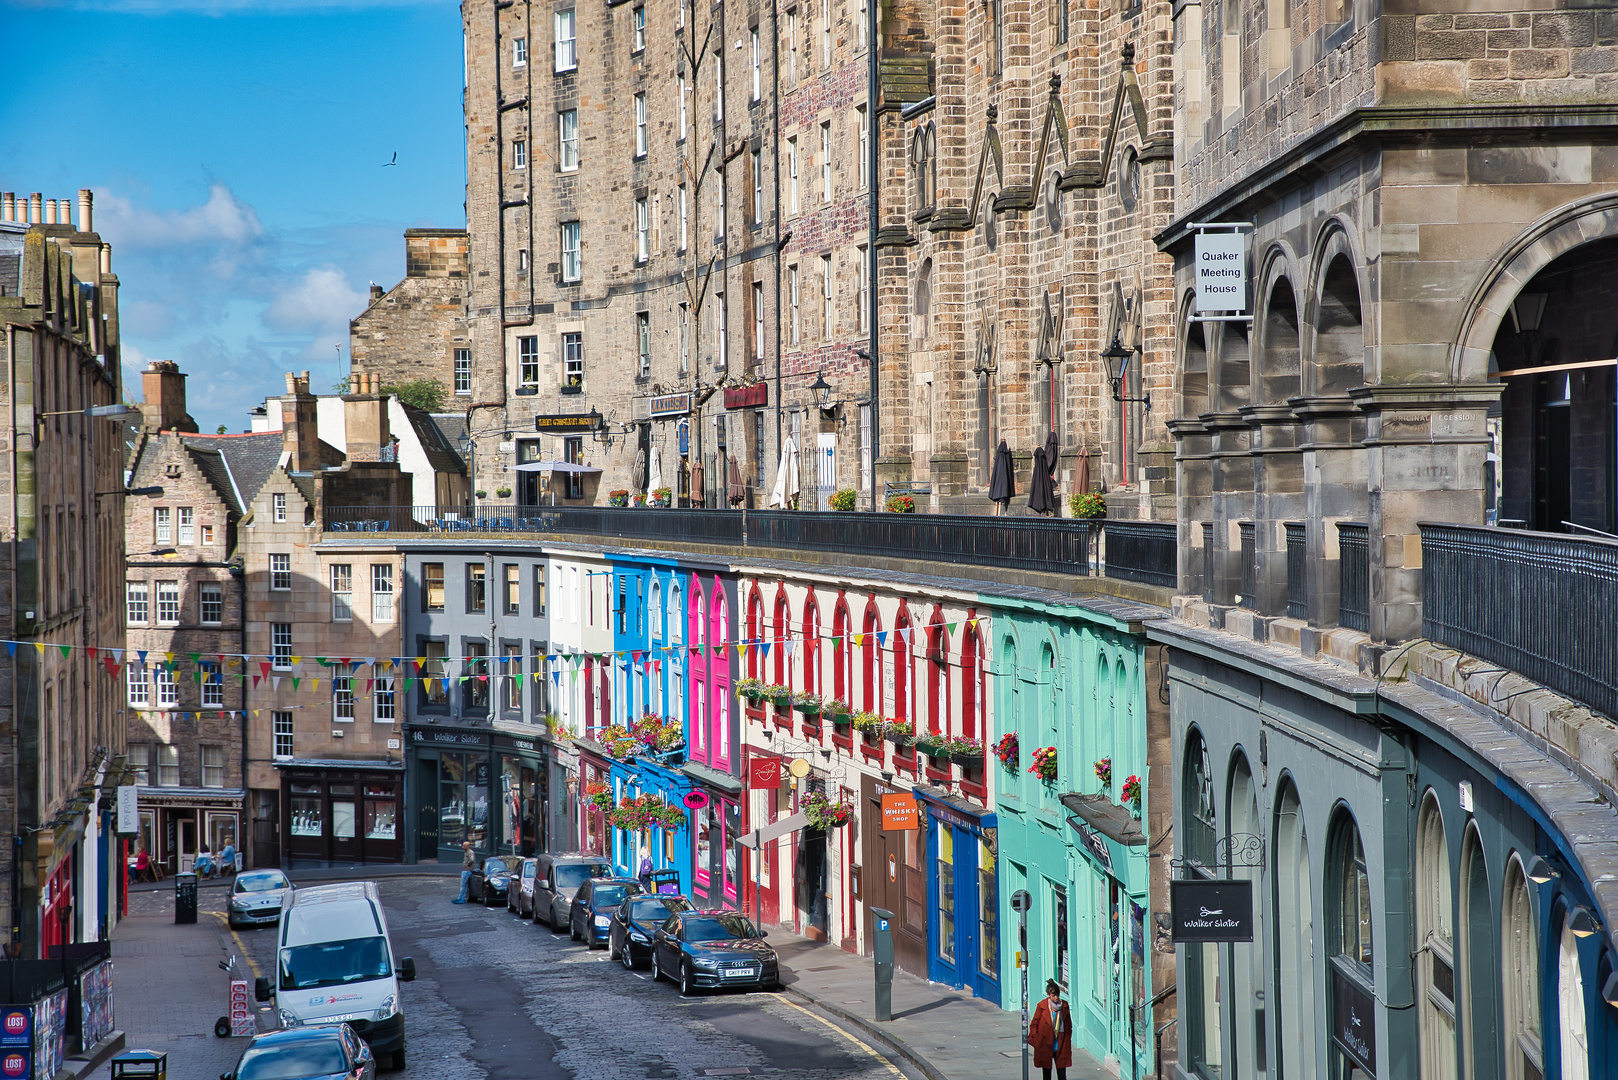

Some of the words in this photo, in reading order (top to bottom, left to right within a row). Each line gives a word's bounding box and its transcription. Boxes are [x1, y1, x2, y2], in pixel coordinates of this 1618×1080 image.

[1202, 251, 1239, 261] Quaker
[1201, 268, 1241, 279] Meeting
[1204, 285, 1237, 293] House
[885, 808, 916, 816] WHISKY
[881, 920, 888, 931] P
[7, 1017, 24, 1027] LOST
[325, 1014, 353, 1023] IVECO
[5, 1058, 23, 1069] LOST
